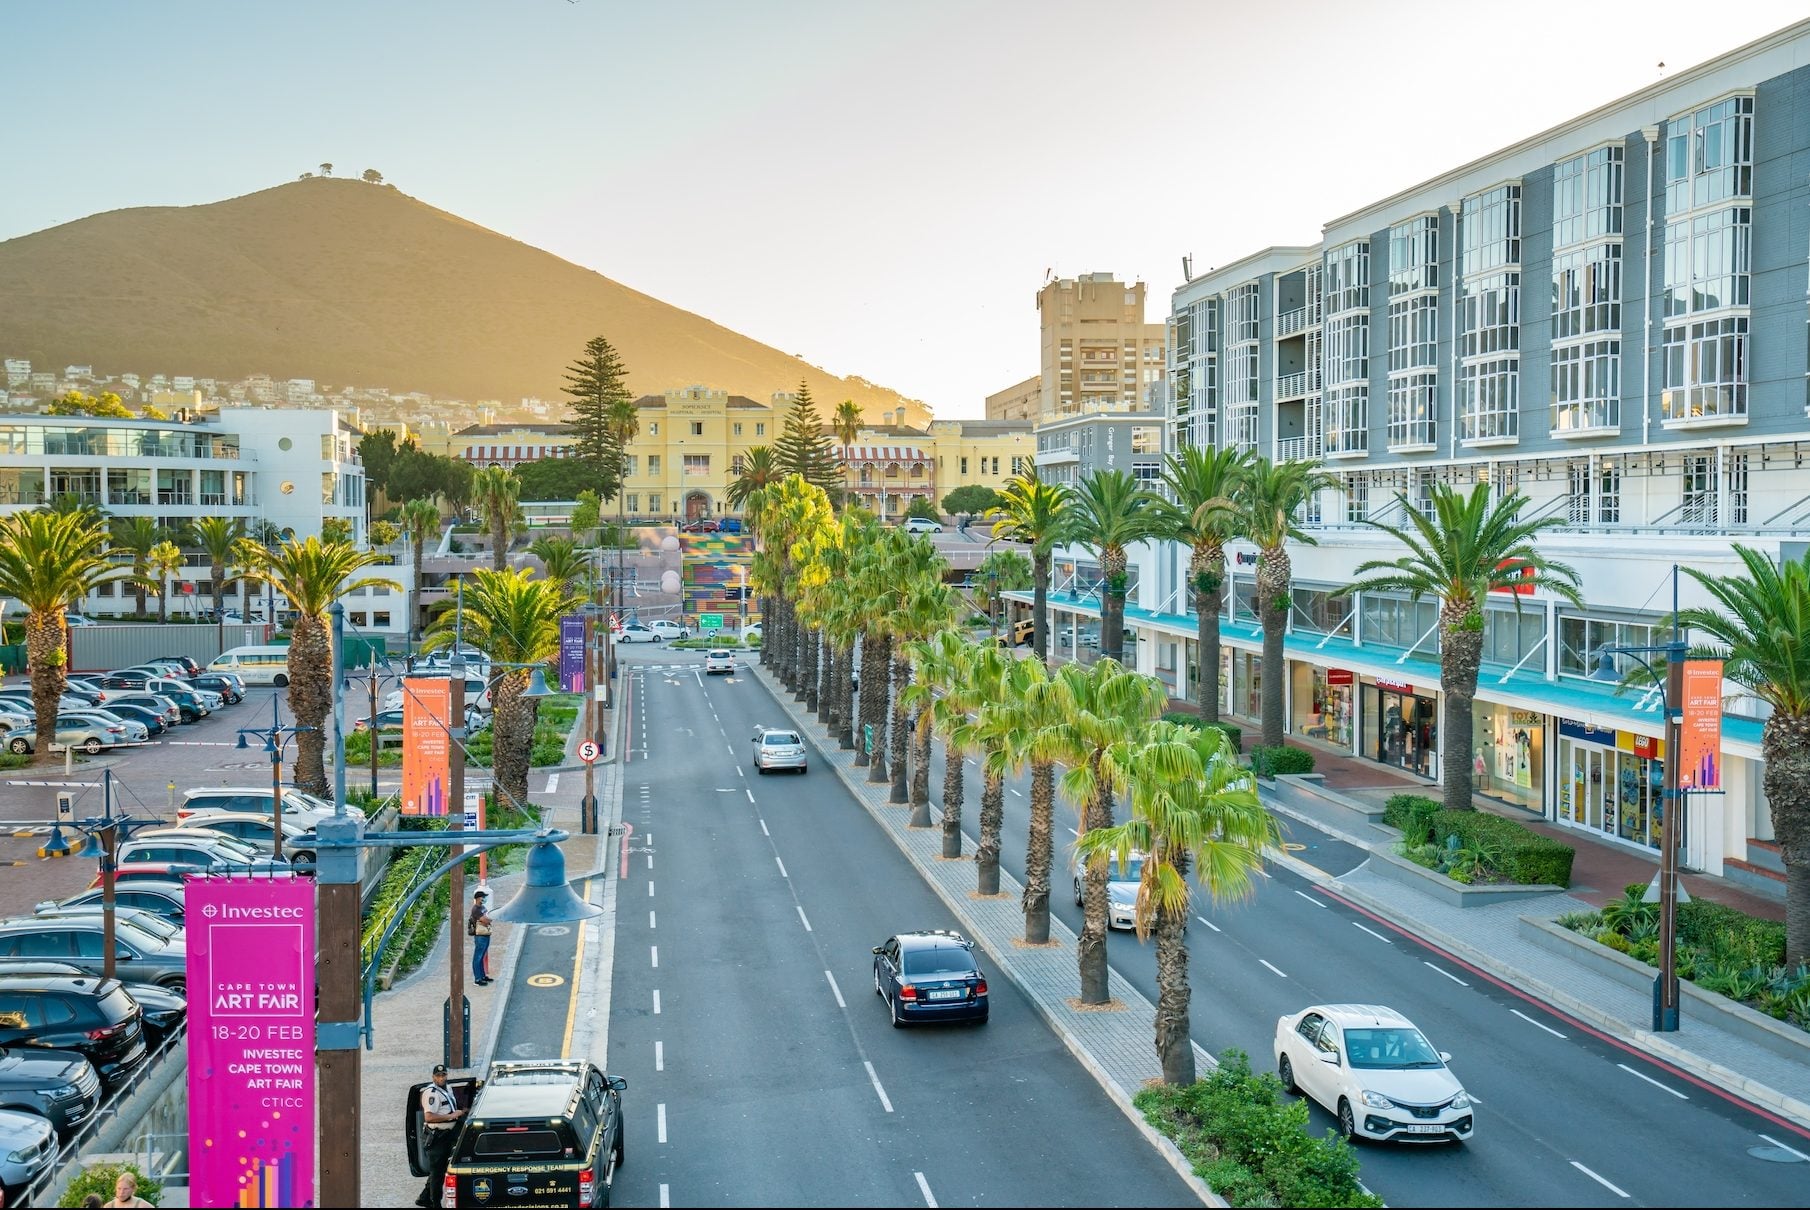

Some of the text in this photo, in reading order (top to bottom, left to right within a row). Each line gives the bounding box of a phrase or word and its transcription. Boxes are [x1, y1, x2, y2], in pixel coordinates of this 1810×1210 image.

[1107, 454, 1115, 466] Bay
[1511, 711, 1529, 720] TOY
[1635, 735, 1649, 748] LEGO
[222, 903, 304, 919] Investec
[218, 983, 297, 991] CAPE TOWN
[215, 993, 254, 1009] ART
[211, 1025, 304, 1040] 18-20 FEB
[243, 1049, 303, 1059] INVESTEC
[228, 1064, 303, 1074] CAPE TOWN
[247, 1079, 303, 1089] ART FAIR
[261, 1097, 304, 1108] CTICC
